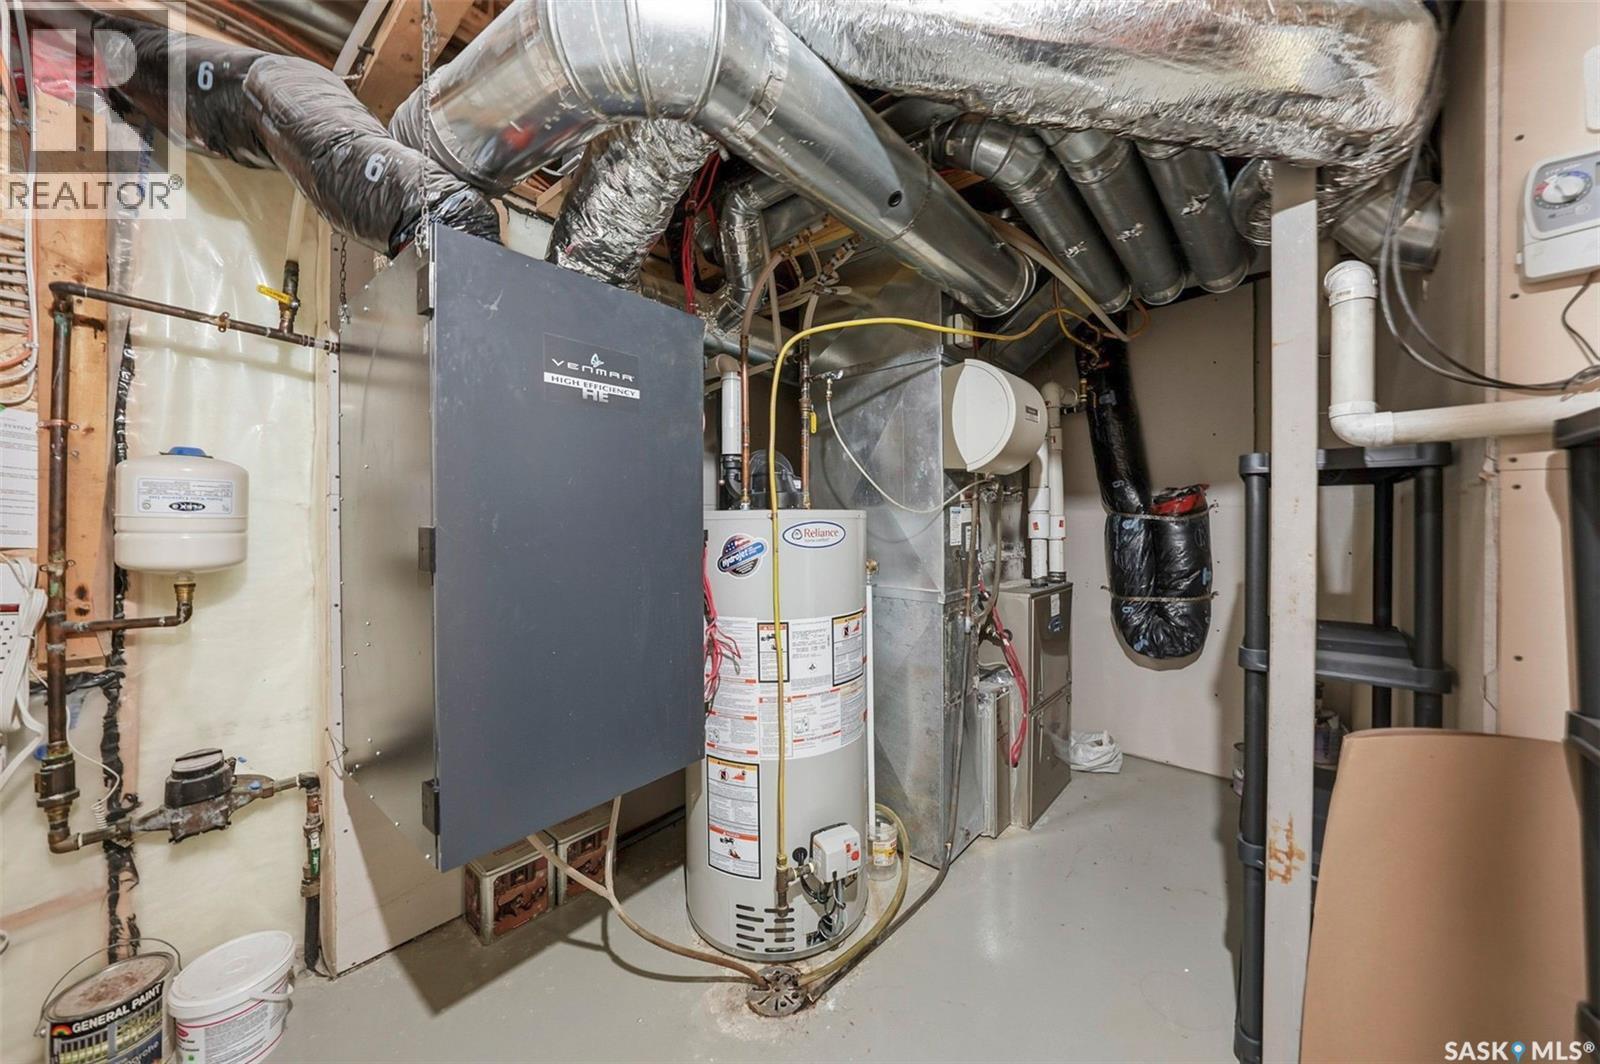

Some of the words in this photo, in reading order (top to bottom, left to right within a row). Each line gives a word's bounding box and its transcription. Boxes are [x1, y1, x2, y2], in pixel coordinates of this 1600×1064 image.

[551, 375, 580, 387] HIGH
[583, 381, 636, 397] EFFICIENCY
[804, 528, 839, 538] Reliance
[72, 1004, 130, 1034] GENERAL
[132, 984, 161, 1010] PAINT
